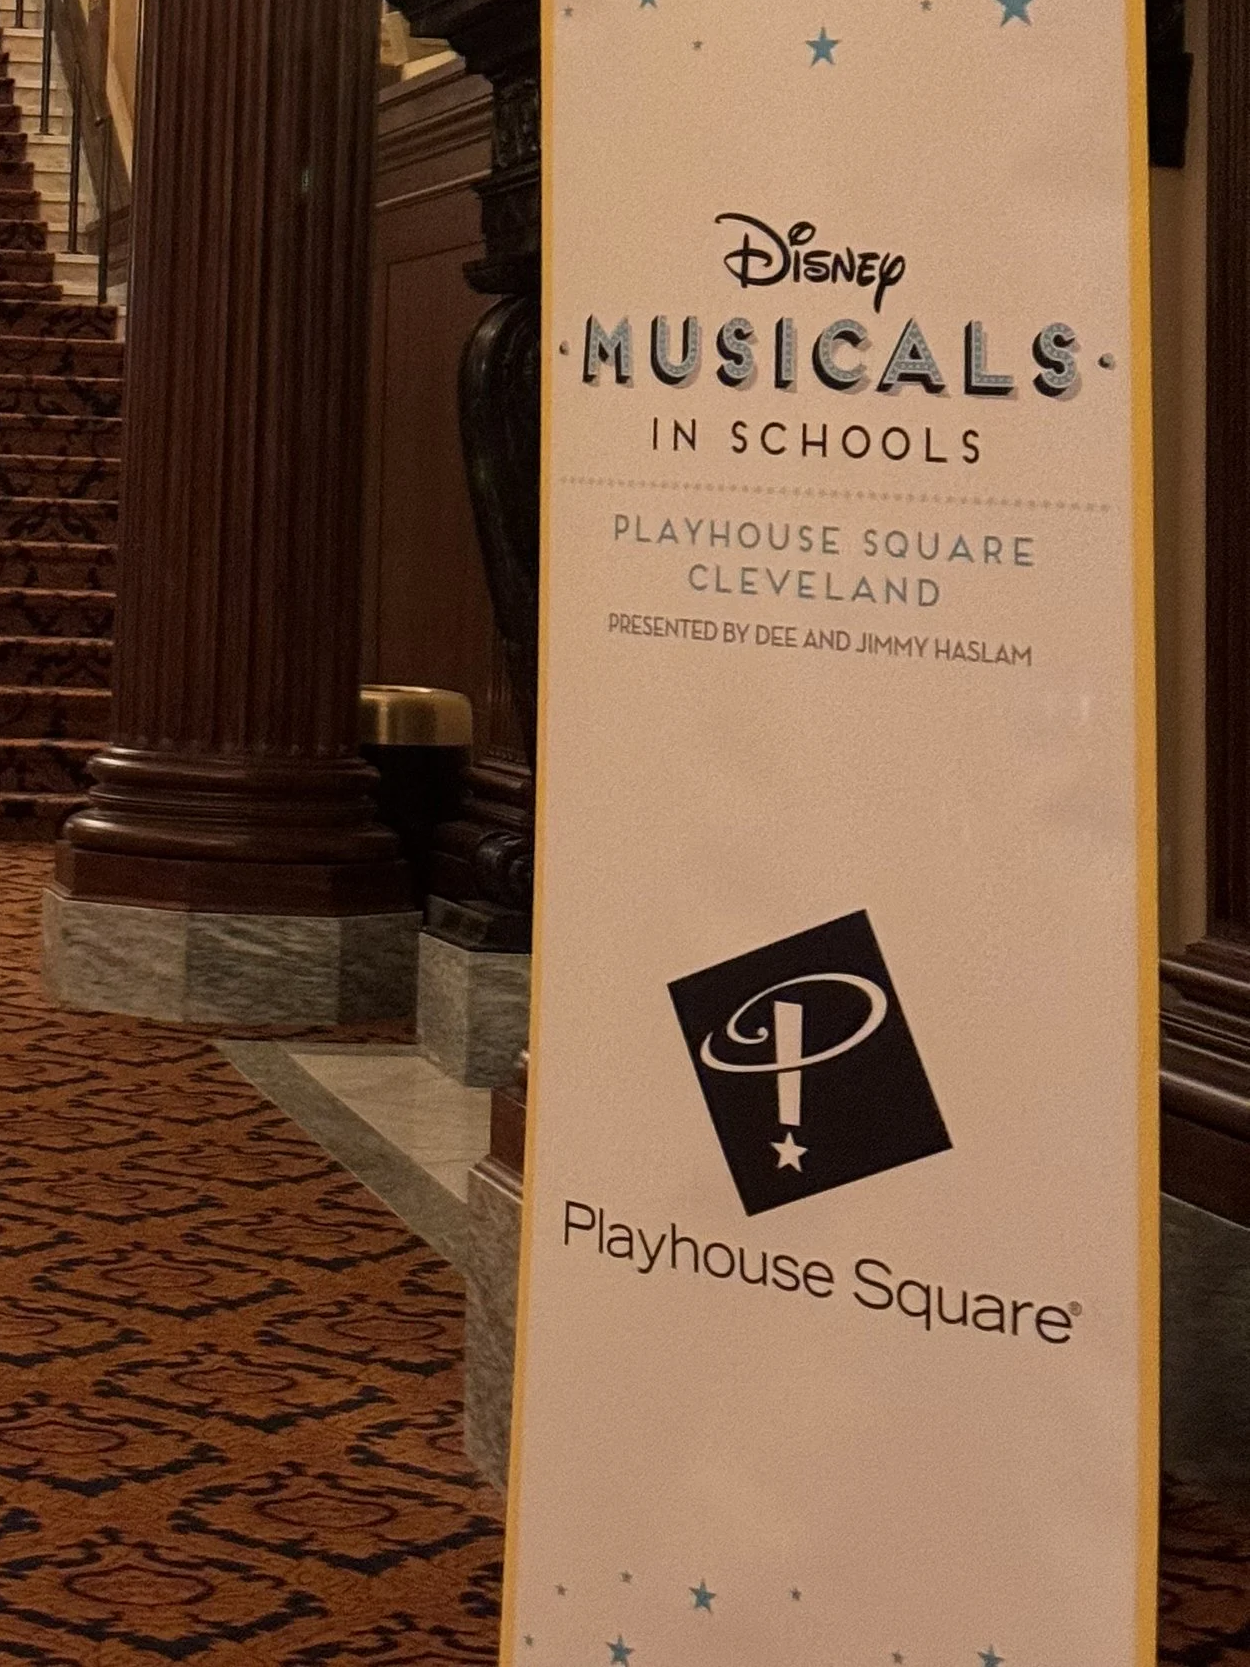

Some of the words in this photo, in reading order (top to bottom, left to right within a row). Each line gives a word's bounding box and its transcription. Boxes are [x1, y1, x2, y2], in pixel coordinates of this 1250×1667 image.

[714, 212, 906, 313] Disney
[581, 314, 1082, 400] MUSICALS
[652, 416, 696, 451] IN
[731, 420, 981, 464] SCHOOLS
[614, 514, 840, 555] PLAYHOUSE
[864, 529, 1035, 567] SQUARE
[688, 564, 941, 607] CLEVELAND
[608, 613, 718, 642] PRESENTED
[723, 622, 749, 644] BY
[756, 625, 798, 648] DEE
[803, 629, 850, 652] AND
[855, 632, 929, 658] JIMMY
[934, 639, 1032, 667] HASLAM
[563, 1200, 834, 1298] Playhouse
